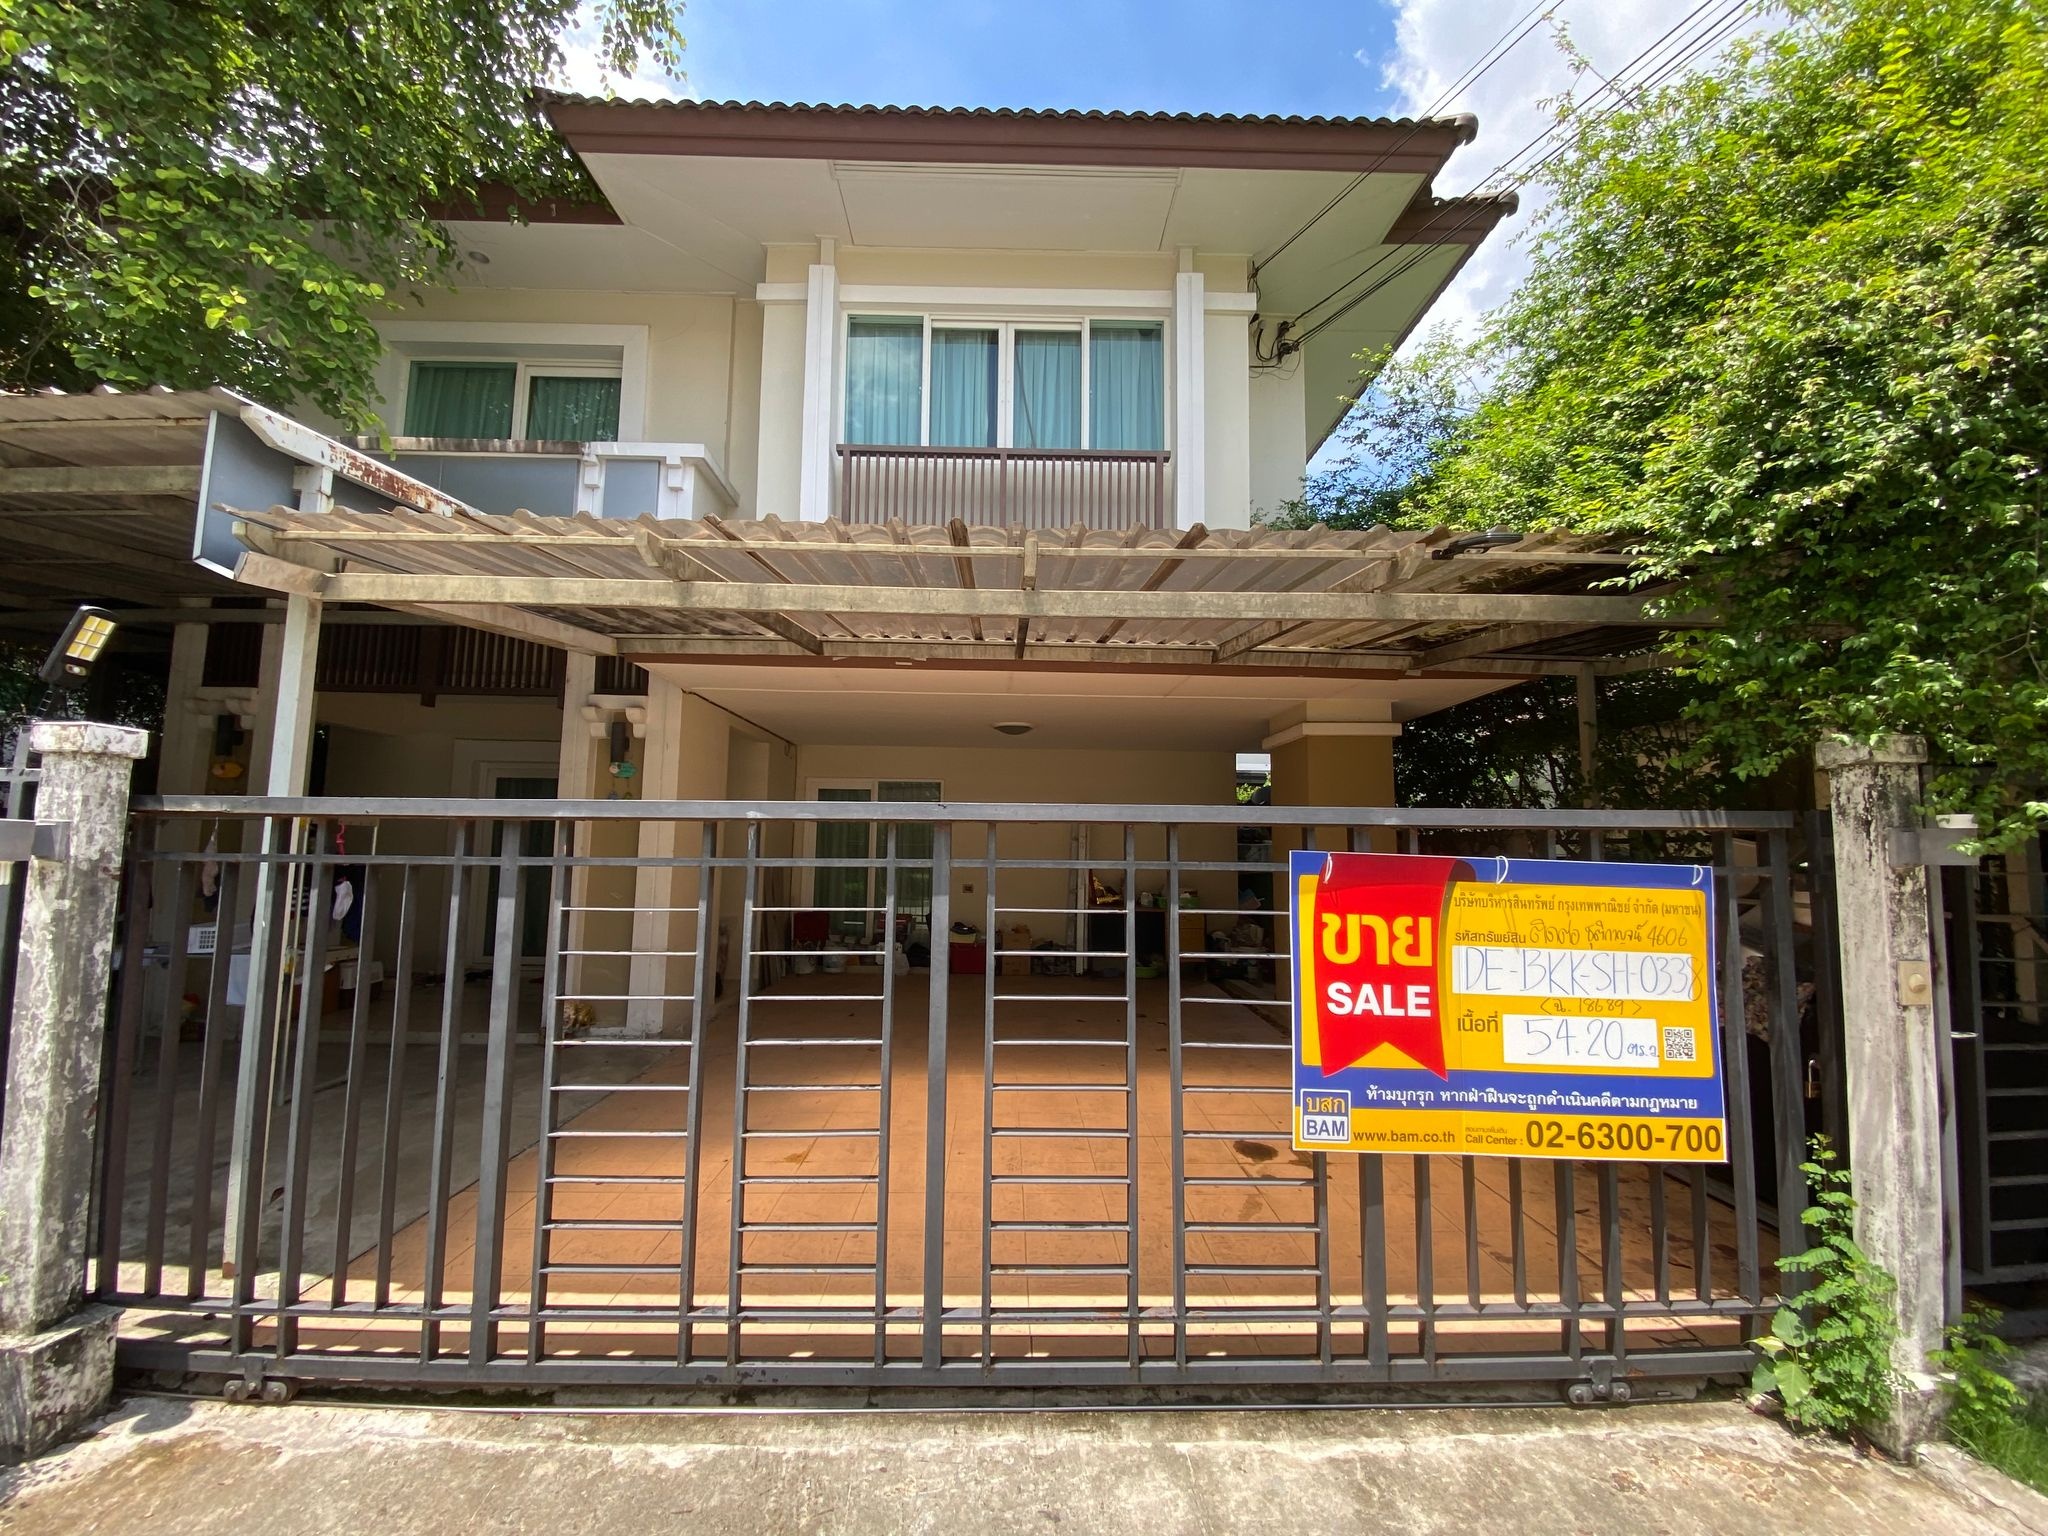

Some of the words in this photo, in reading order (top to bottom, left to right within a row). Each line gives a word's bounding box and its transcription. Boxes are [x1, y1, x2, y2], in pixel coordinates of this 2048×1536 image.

[1454, 892, 1555, 912] บริษัทบริหารสินทรัพย์
[1632, 900, 1658, 915] จำกัด
[1661, 901, 1702, 917] (มหาชน)
[1322, 912, 1433, 967] ขาย
[1455, 929, 1526, 944] รหัสทรัพย์สิน
[1647, 925, 1688, 947] 4606
[1326, 982, 1432, 1018] SALE
[1457, 1009, 1499, 1033] เนื้อที่
[1307, 1096, 1346, 1115] บสก
[1366, 1087, 1434, 1110] ห้ามบุกรุก
[1440, 1088, 1698, 1113] หากฝ่าฝืนจะถูกดำเนินคดีตามกฎหมาย
[1306, 1118, 1346, 1137] BAM
[1352, 1130, 1456, 1144] www.bam.co.th
[1465, 1133, 1483, 1144] Call
[1485, 1134, 1517, 1145] Center
[1526, 1120, 1722, 1152] 02-6300-700
